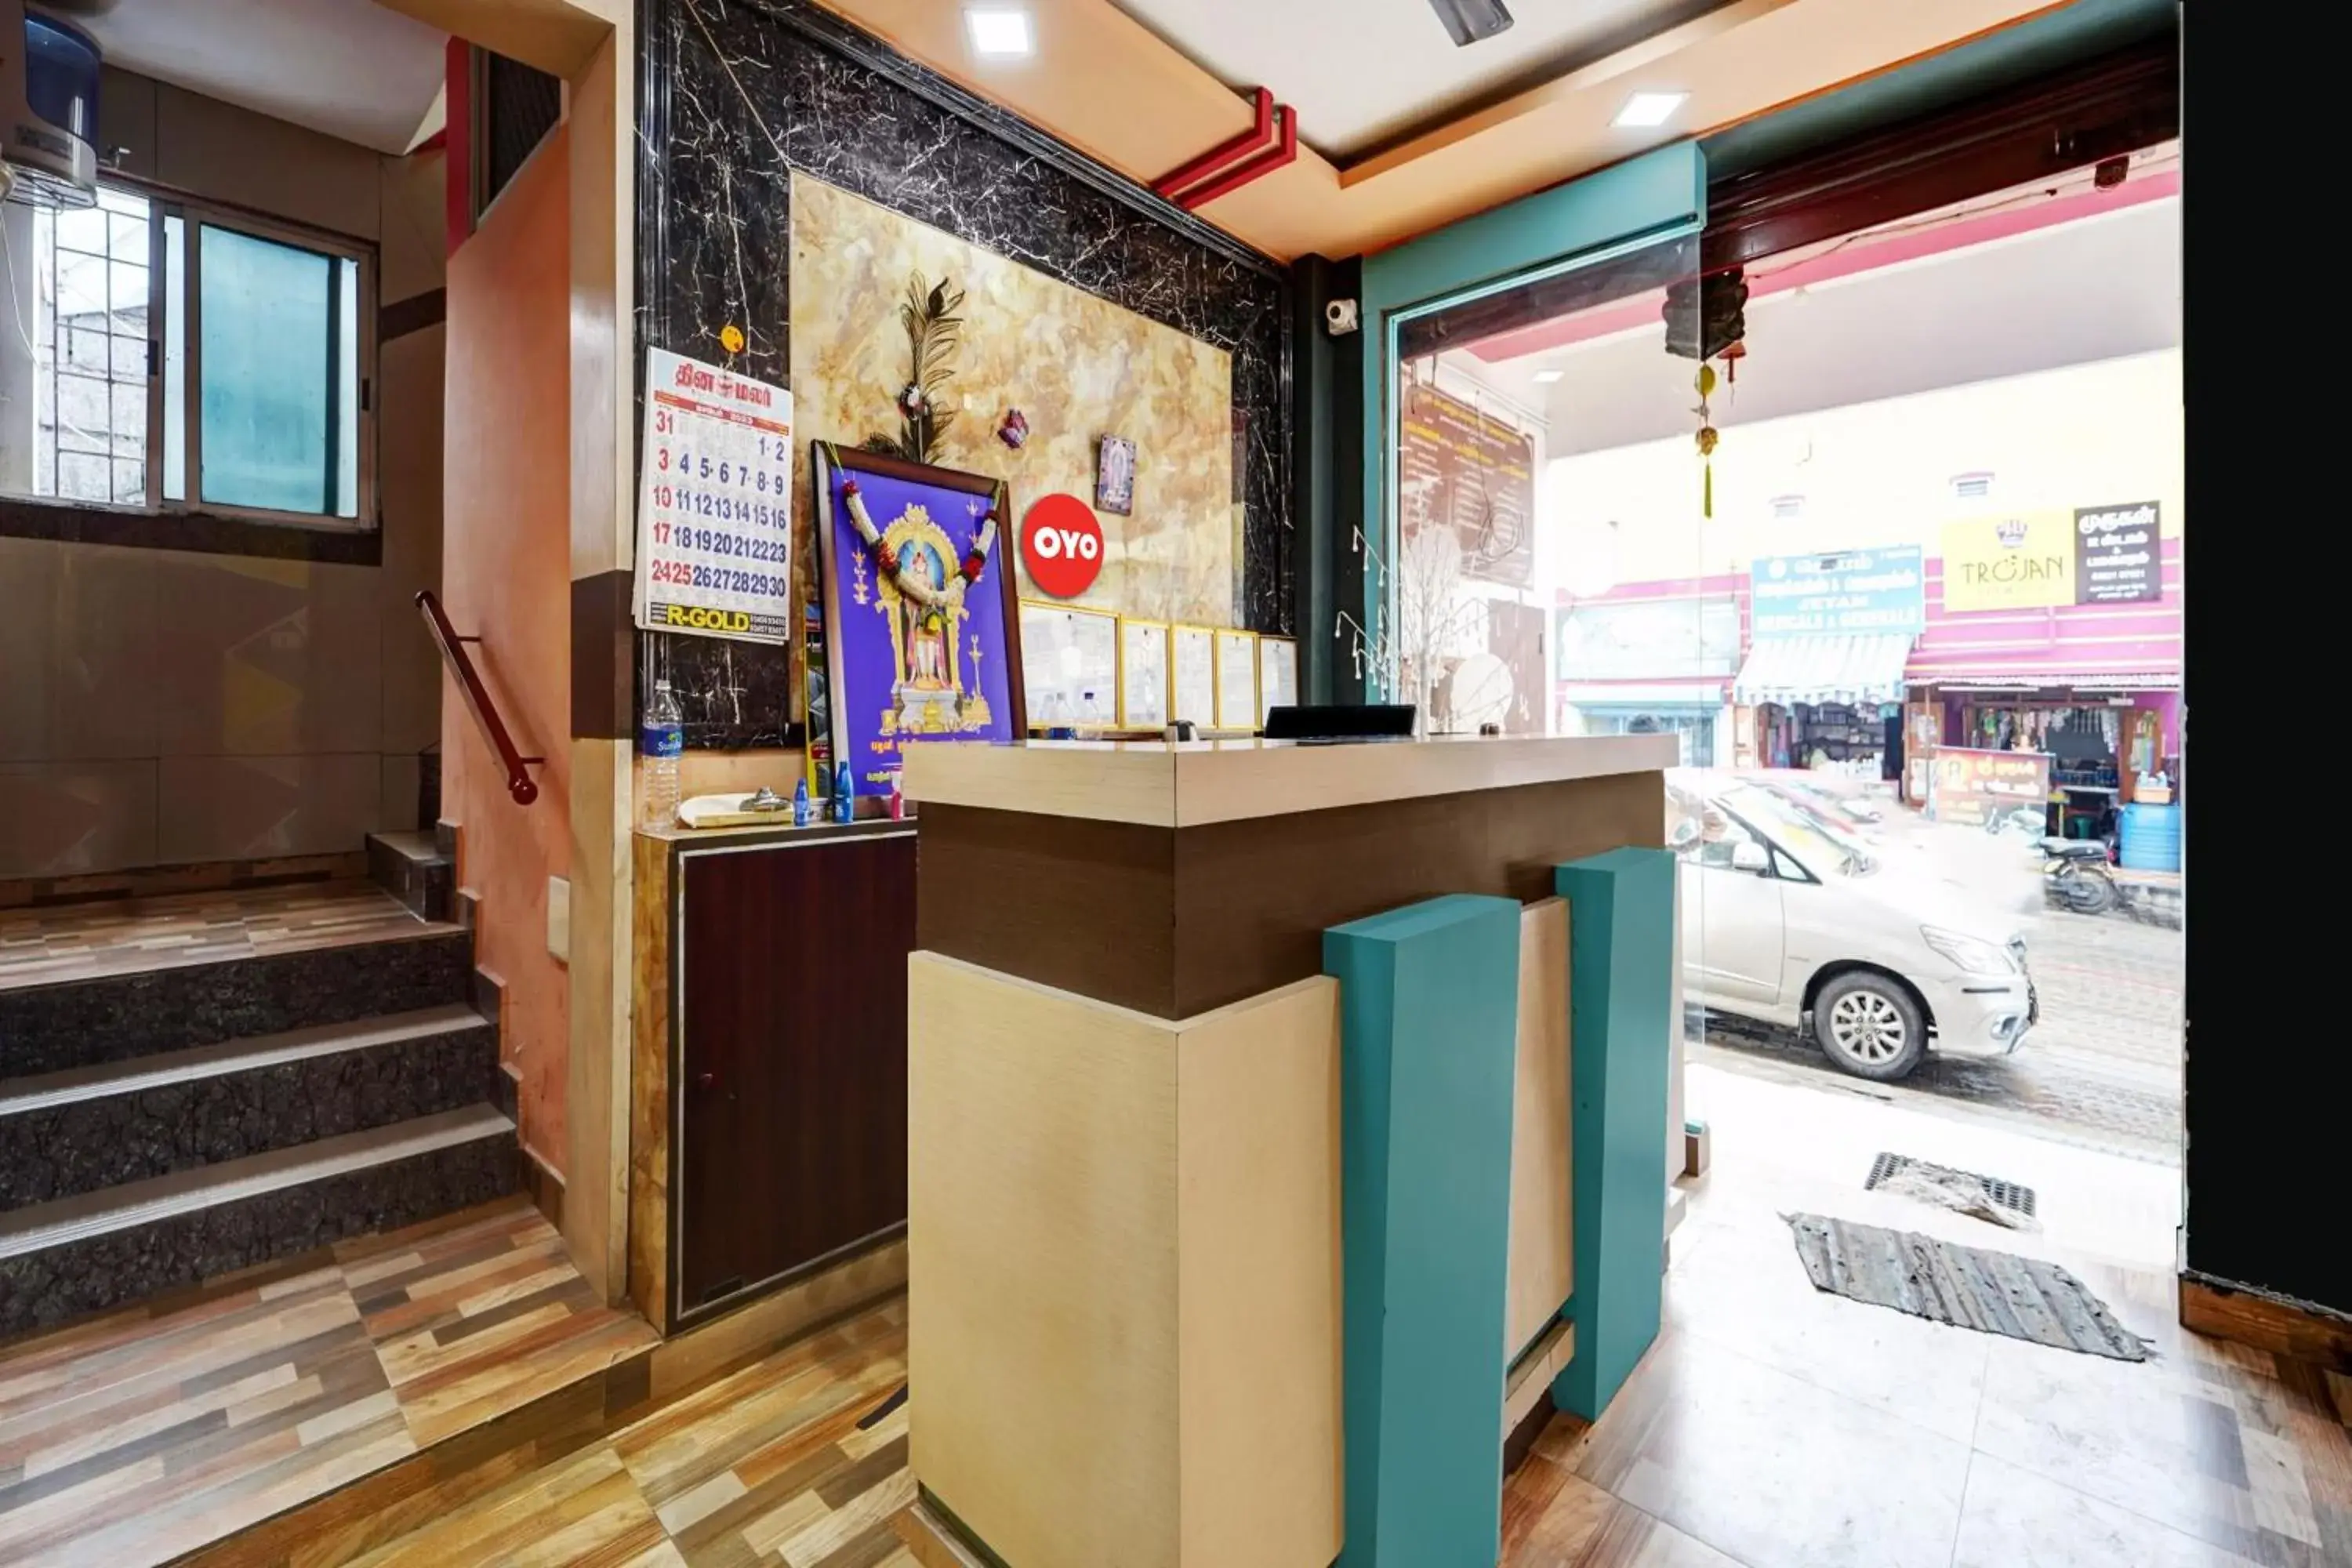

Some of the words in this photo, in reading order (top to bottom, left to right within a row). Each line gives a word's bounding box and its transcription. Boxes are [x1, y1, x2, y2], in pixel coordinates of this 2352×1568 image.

[655, 410, 673, 434] 31
[759, 437, 766, 456] 1
[775, 441, 785, 462] 2
[659, 448, 669, 470] 3
[680, 453, 690, 474] 4
[700, 458, 710, 478] 5
[720, 462, 730, 484] 6
[739, 466, 748, 487] 7
[757, 471, 766, 492] 8
[775, 475, 784, 495] 9
[653, 485, 672, 508] 10
[677, 489, 691, 511] 11
[695, 494, 713, 516] 12
[715, 497, 731, 519] 13
[734, 501, 750, 523] 14
[754, 506, 768, 526] 15
[771, 509, 786, 530] 16
[653, 521, 671, 545] 17
[674, 526, 692, 548] 18
[695, 529, 711, 551] 19
[713, 532, 732, 555] 20
[734, 535, 750, 559] 21
[752, 539, 768, 561] 22
[769, 542, 786, 564] 23
[1034, 526, 1098, 561] OYO
[652, 559, 672, 582] 24
[672, 562, 691, 586] 25
[692, 565, 712, 587] 26
[713, 568, 731, 590] 27
[731, 571, 750, 593] 28
[750, 573, 768, 595] 29
[769, 577, 786, 597] 30
[1961, 555, 2063, 584] TROJAN
[667, 604, 750, 631] R-GOLD
